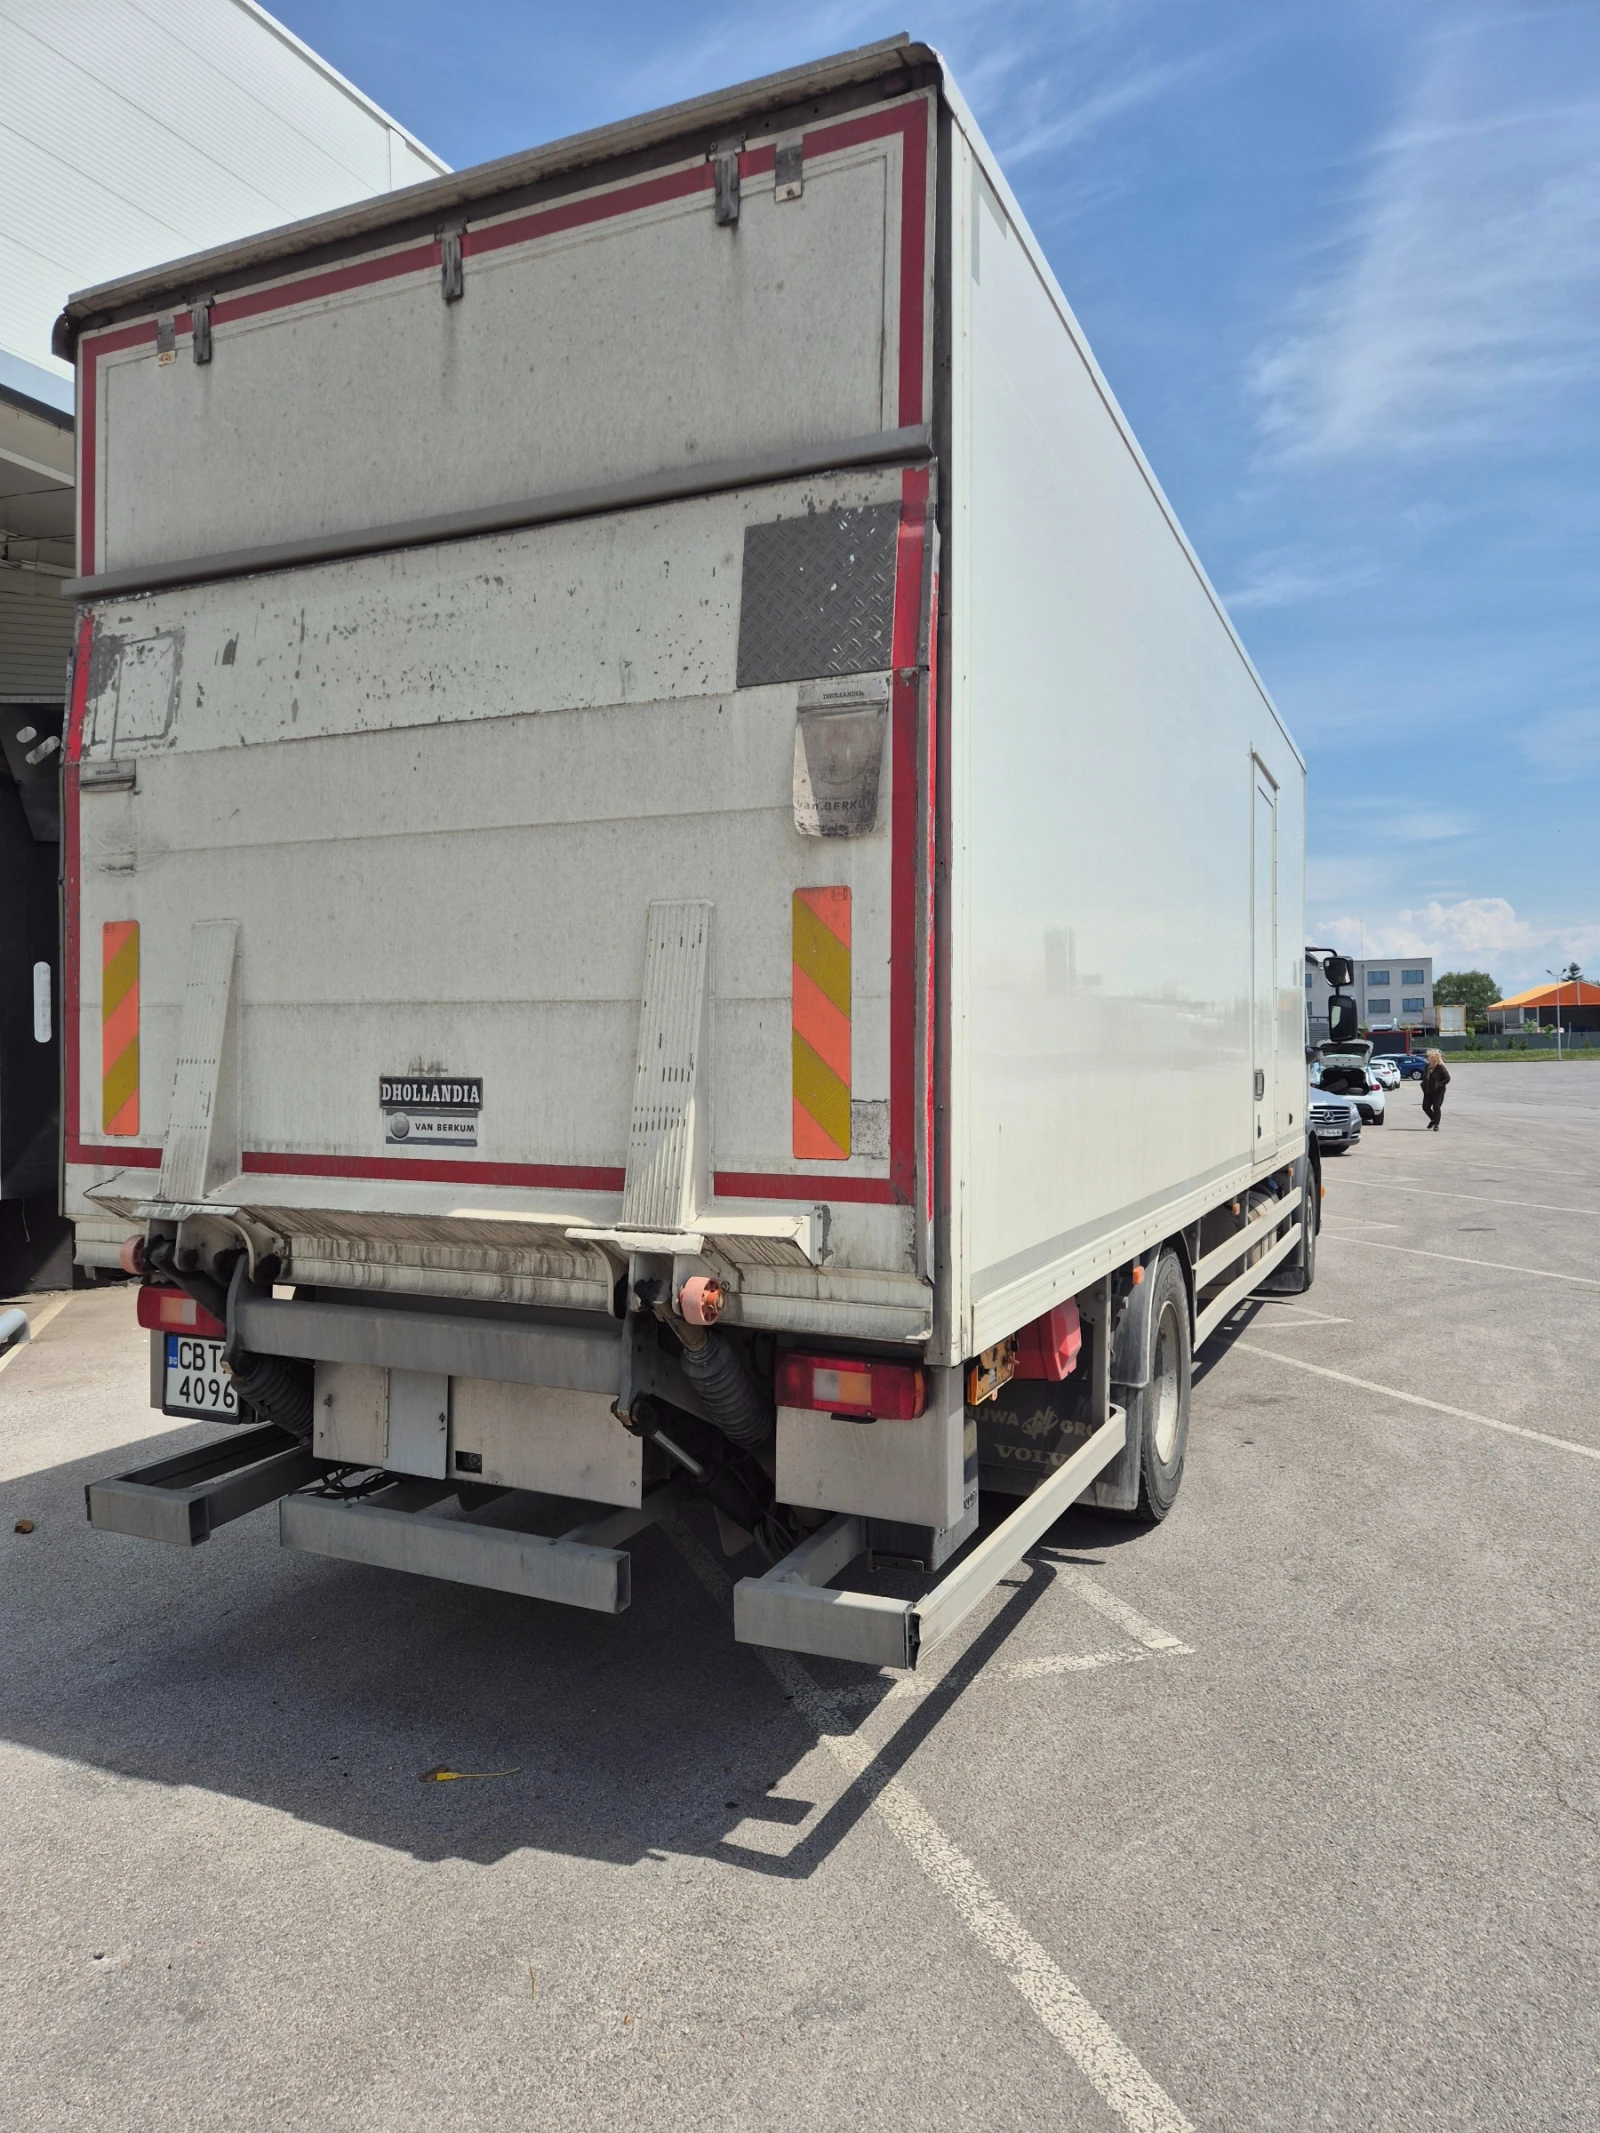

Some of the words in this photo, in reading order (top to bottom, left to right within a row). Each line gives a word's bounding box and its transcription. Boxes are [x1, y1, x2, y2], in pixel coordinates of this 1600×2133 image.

[381, 1083, 480, 1104] DHOLLANDIA
[415, 1122, 433, 1131] VAN
[436, 1123, 475, 1133] BERKUM
[168, 1355, 178, 1365] BG
[179, 1341, 226, 1373] CBT
[179, 1375, 235, 1409] 4096
[994, 1443, 1069, 1467] VOLV
